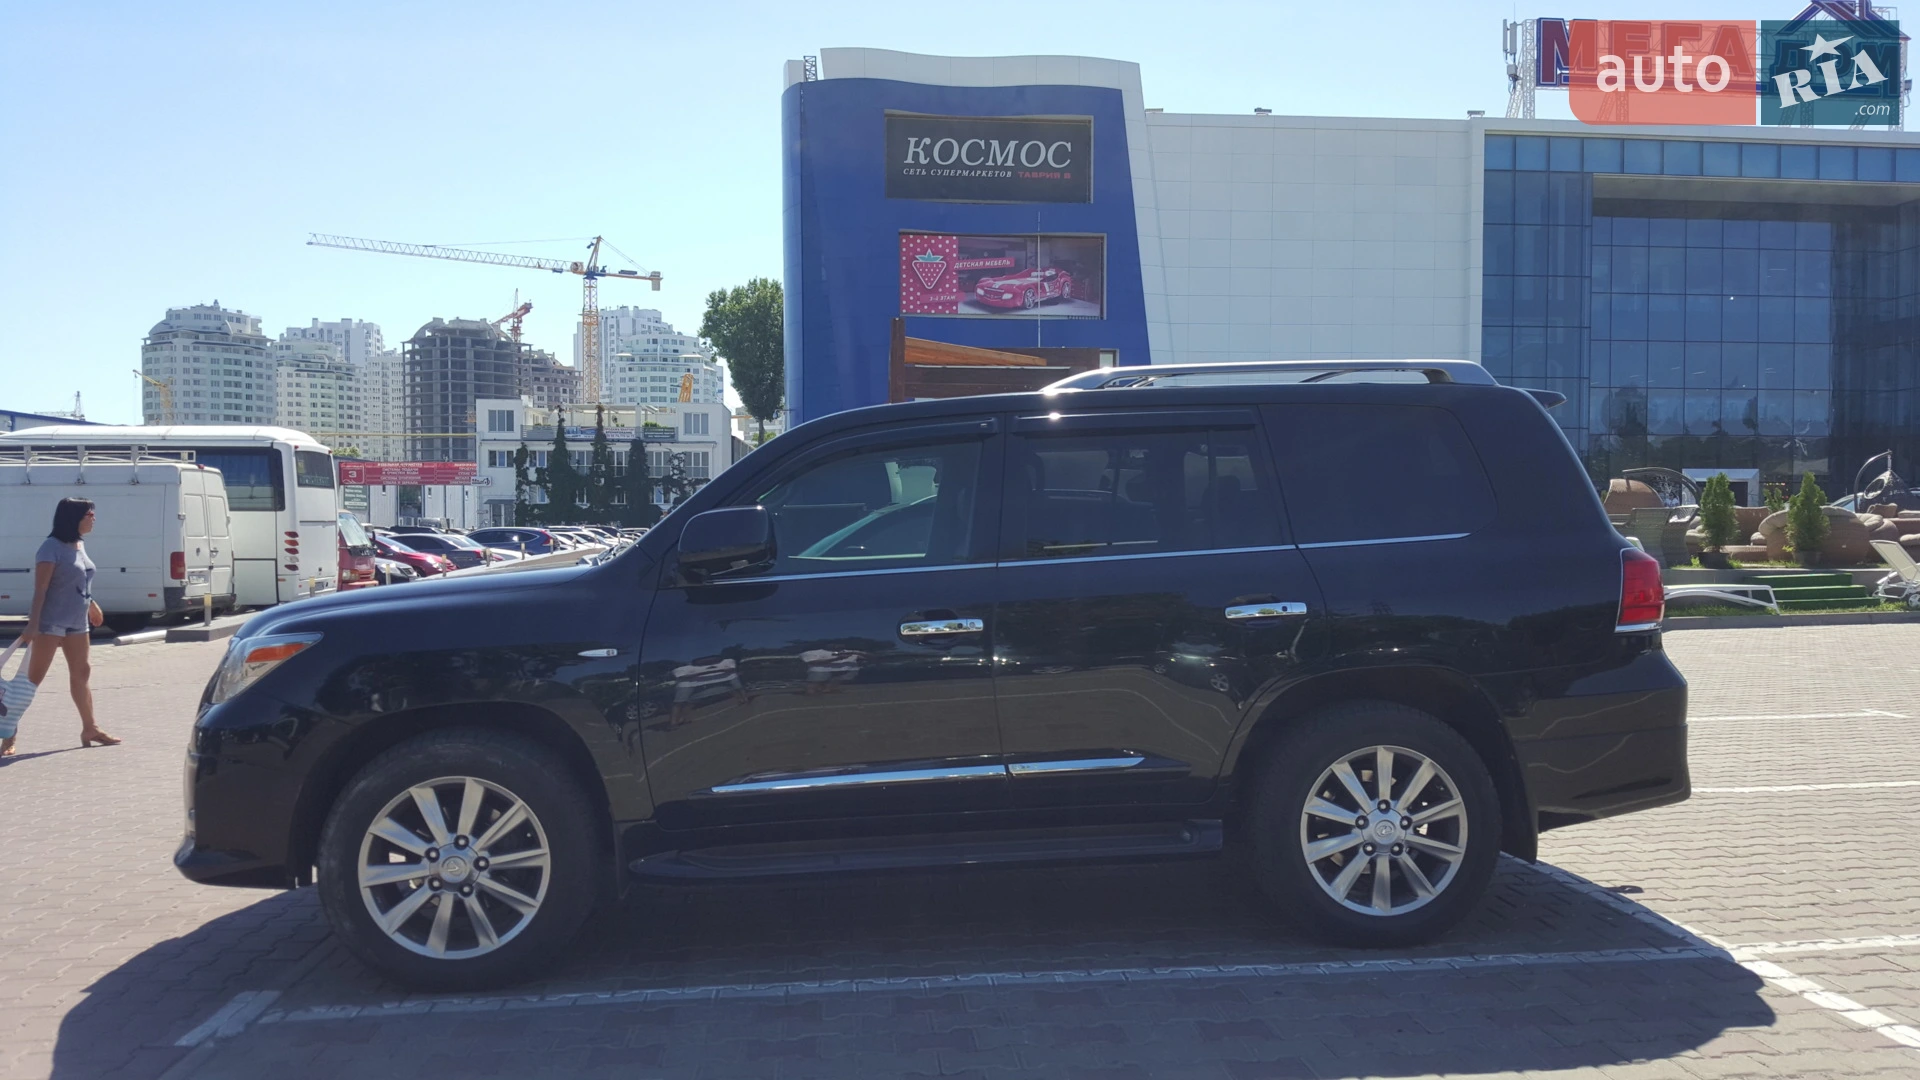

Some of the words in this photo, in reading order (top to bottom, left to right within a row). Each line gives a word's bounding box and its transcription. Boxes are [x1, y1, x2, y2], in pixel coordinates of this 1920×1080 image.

[903, 137, 1072, 169] КОСМОС
[903, 168, 926, 176] СЕТЬ
[930, 169, 1012, 178] СУПЕРМАРКЕТОВ
[1018, 171, 1060, 179] ТАВРИЯ
[954, 261, 983, 269] ДЕТСКАЯ
